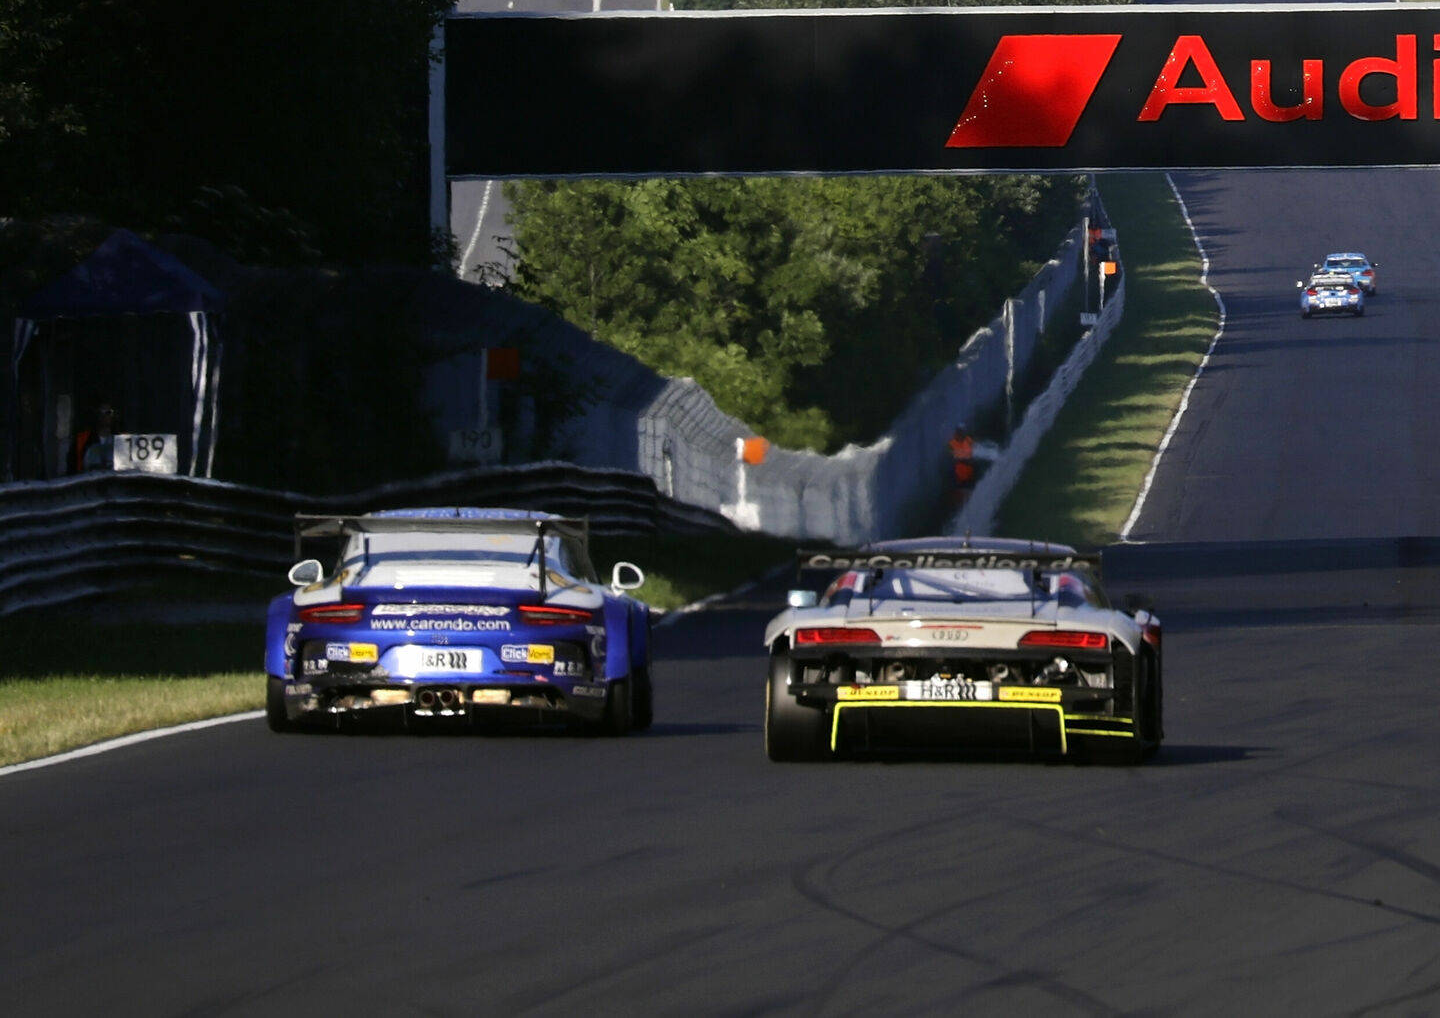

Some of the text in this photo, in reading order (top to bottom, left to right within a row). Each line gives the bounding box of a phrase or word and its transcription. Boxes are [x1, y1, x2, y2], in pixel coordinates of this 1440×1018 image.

[461, 430, 491, 449] 190
[125, 436, 165, 461] 189
[808, 554, 1091, 569] CarCollectionde
[370, 617, 511, 631] www.carondo.com
